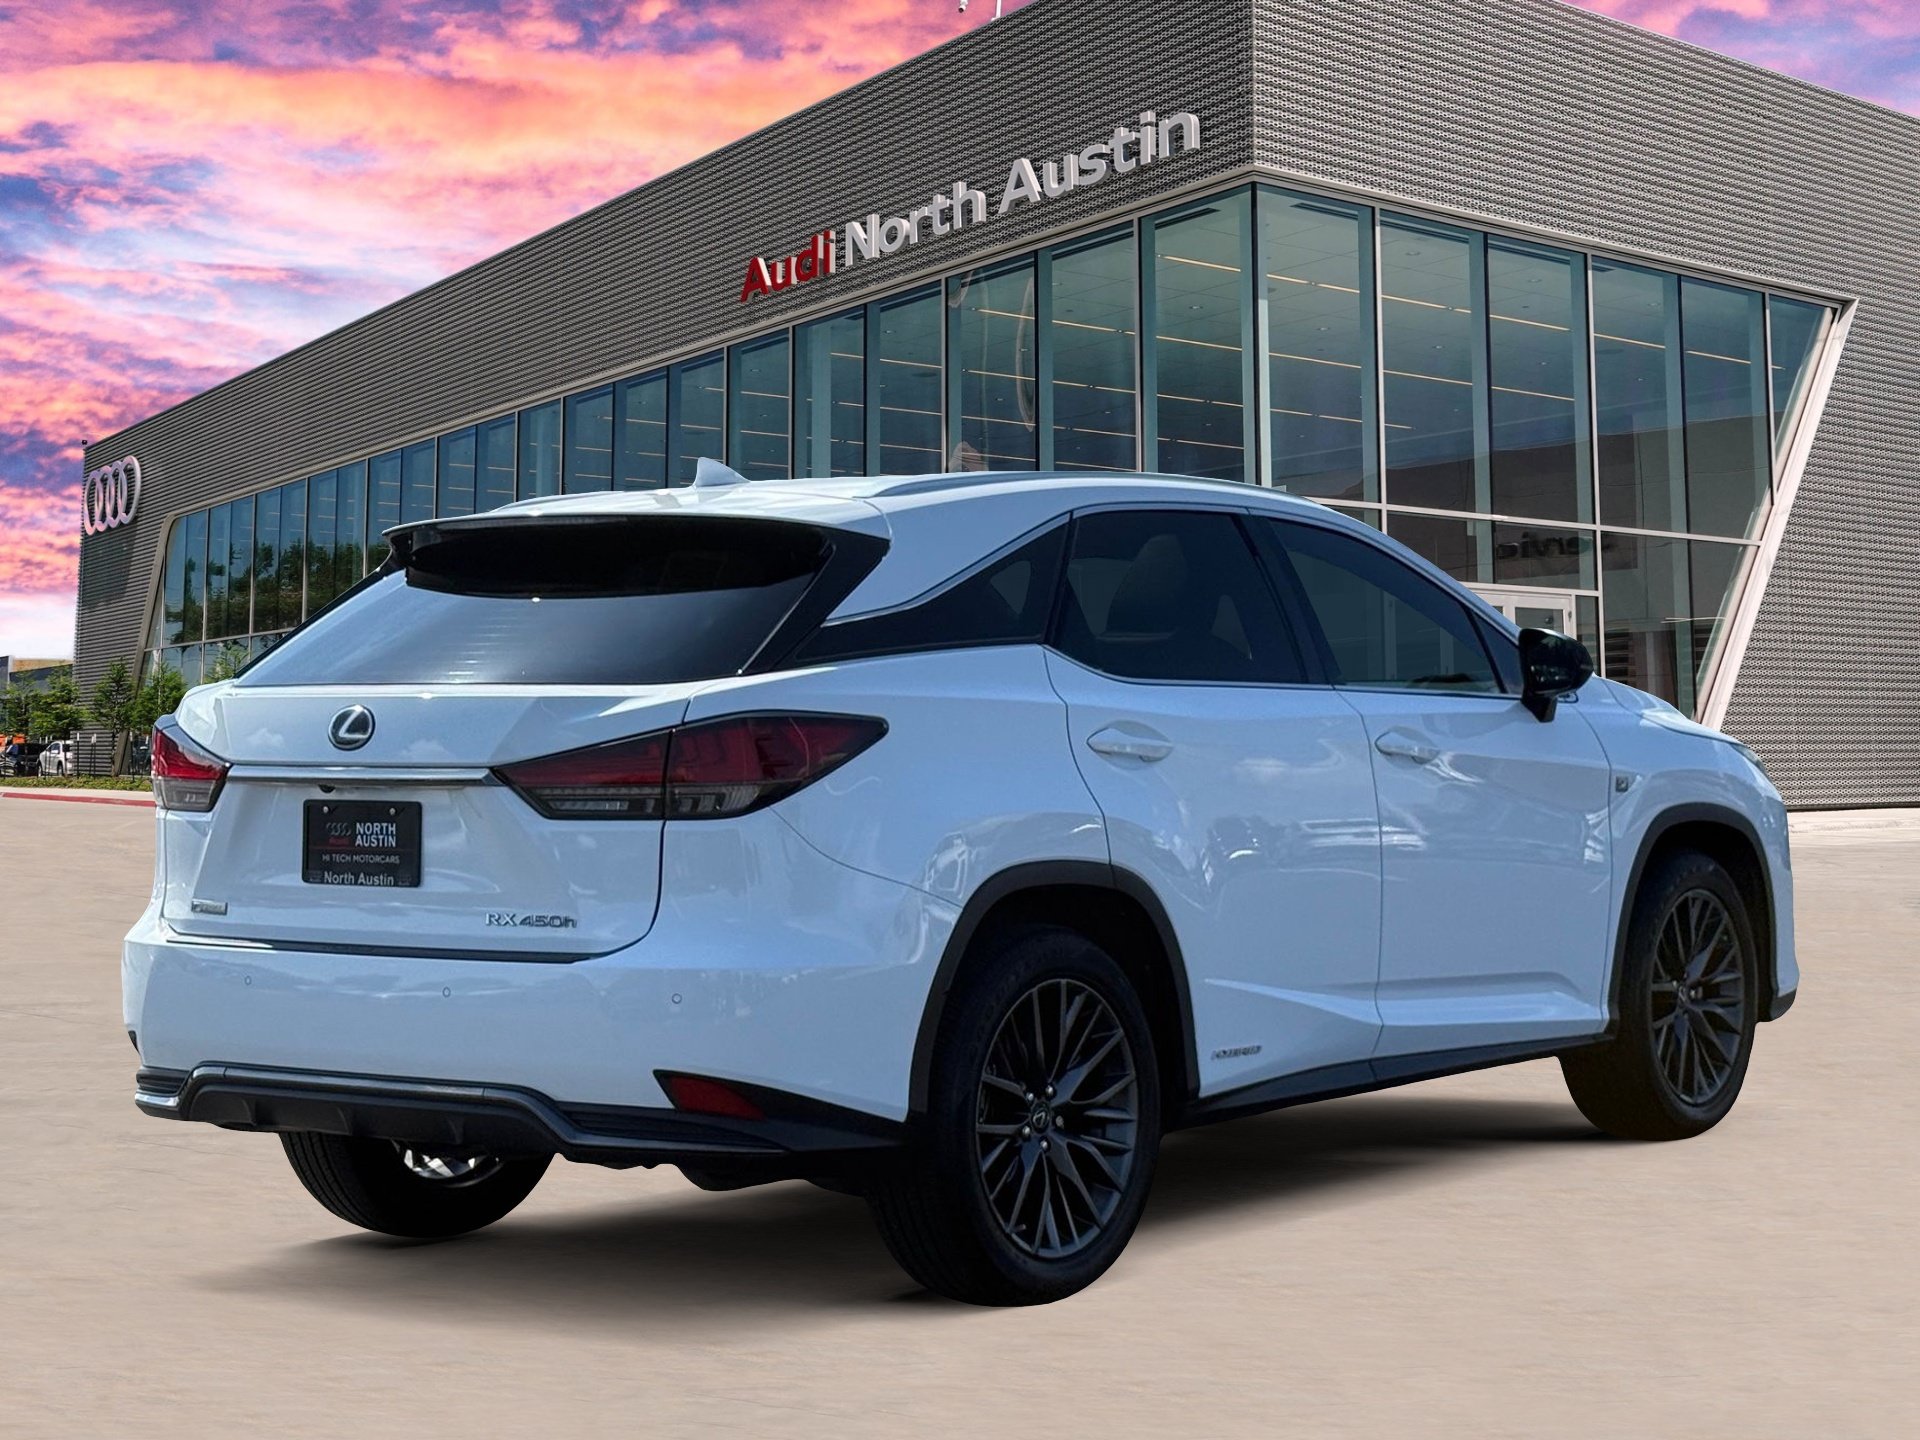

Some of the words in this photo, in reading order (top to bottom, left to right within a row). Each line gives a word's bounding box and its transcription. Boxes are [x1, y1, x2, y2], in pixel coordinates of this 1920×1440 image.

[740, 229, 836, 301] Audi
[845, 181, 986, 267] North
[999, 110, 1200, 213] Austin
[355, 822, 396, 835] NORTH
[355, 835, 396, 847] AUSTIN
[332, 854, 351, 863] TECH
[353, 855, 400, 864] MOTORCARS
[324, 871, 354, 884] North
[358, 872, 394, 886] Austin
